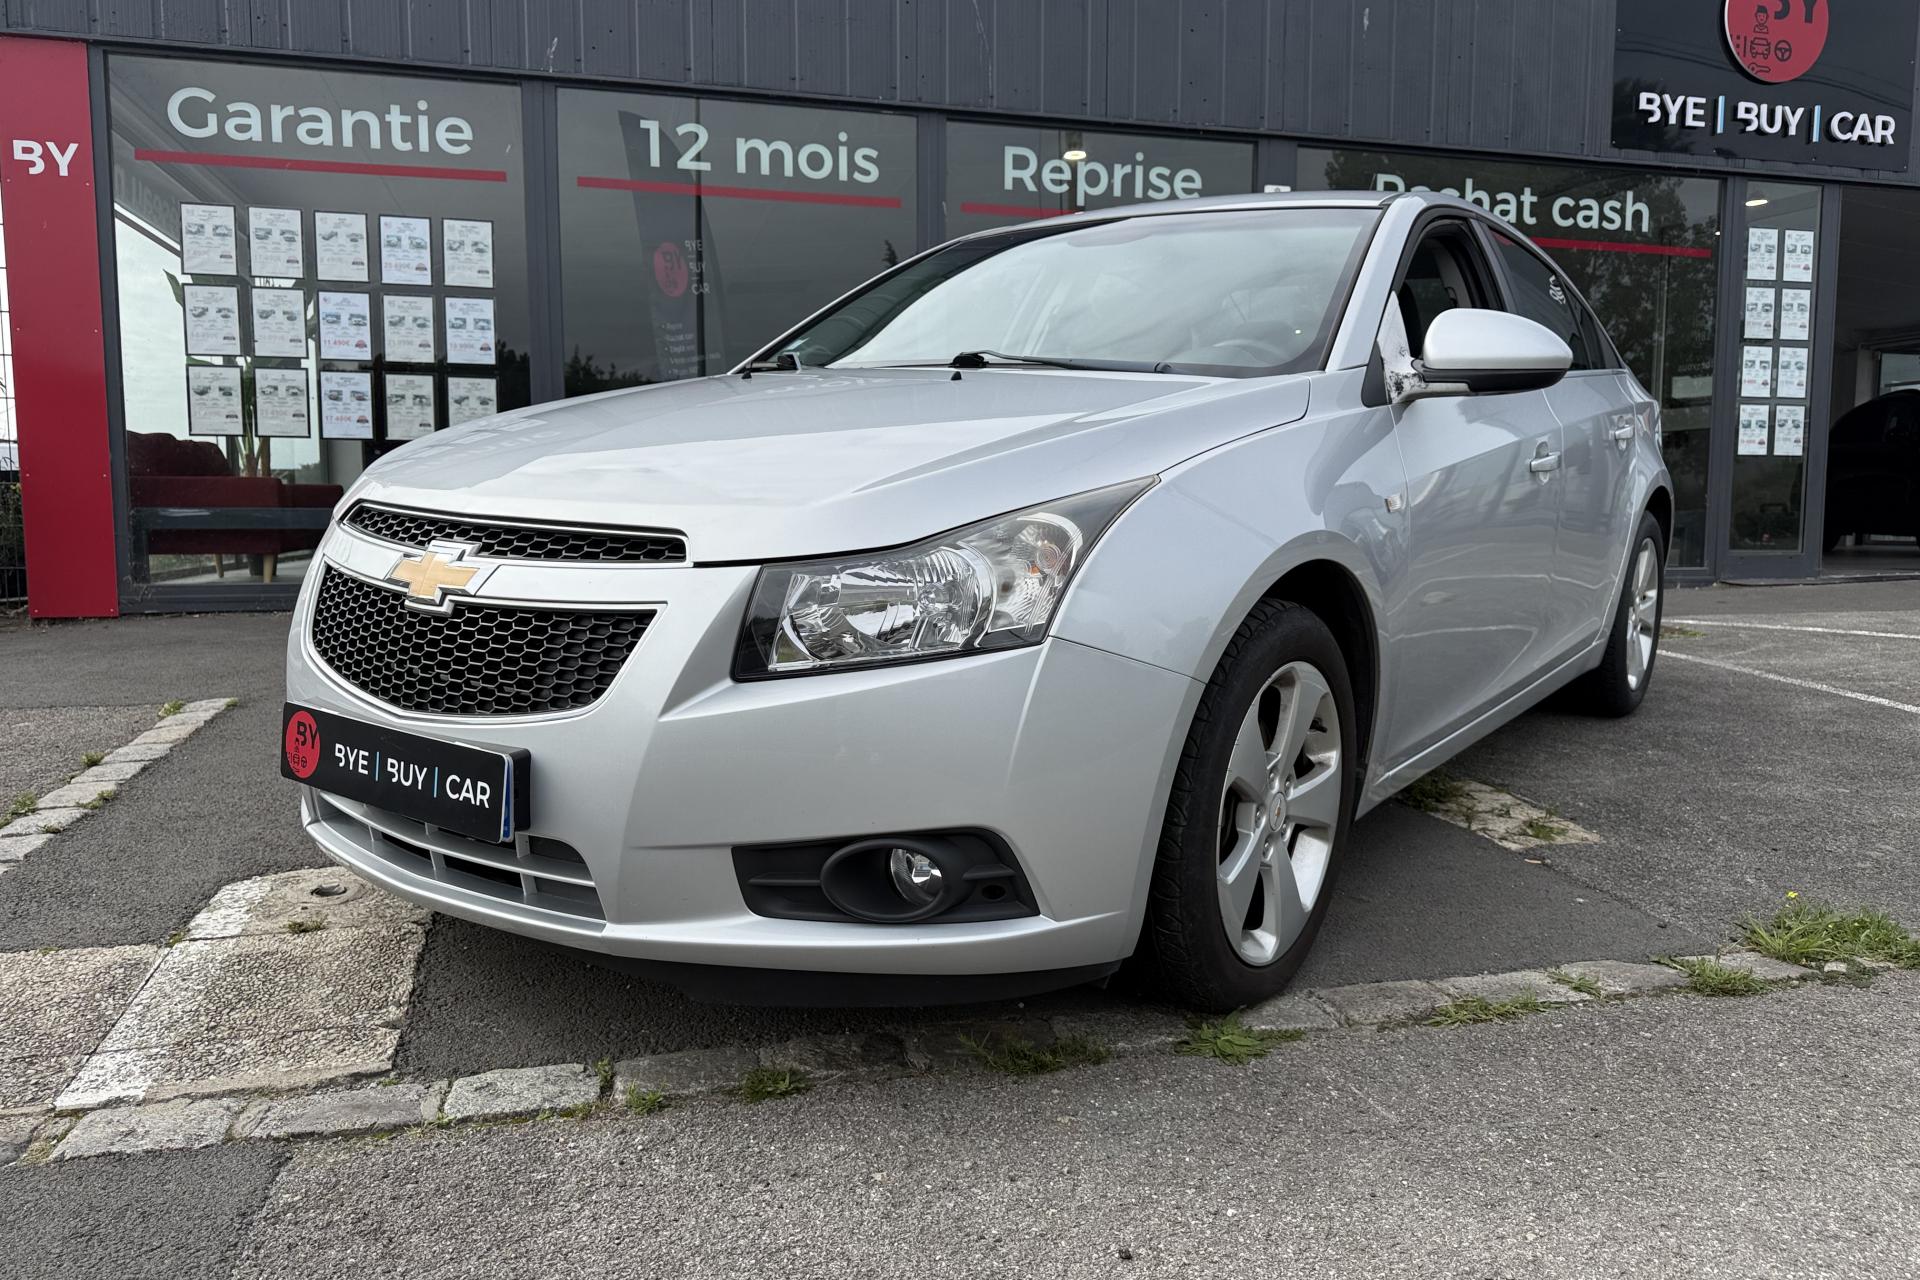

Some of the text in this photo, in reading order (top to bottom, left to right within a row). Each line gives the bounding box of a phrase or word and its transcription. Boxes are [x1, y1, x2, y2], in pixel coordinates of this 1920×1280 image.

[166, 86, 474, 155] Garantie
[1638, 91, 1896, 144] BYE BUY CAR
[12, 138, 79, 177] BY
[639, 119, 880, 184] 12 mois
[1003, 145, 1203, 207] Reprise
[1551, 190, 1651, 233] cash
[296, 720, 319, 749] BY
[335, 743, 490, 808] BYE BUY CAR
